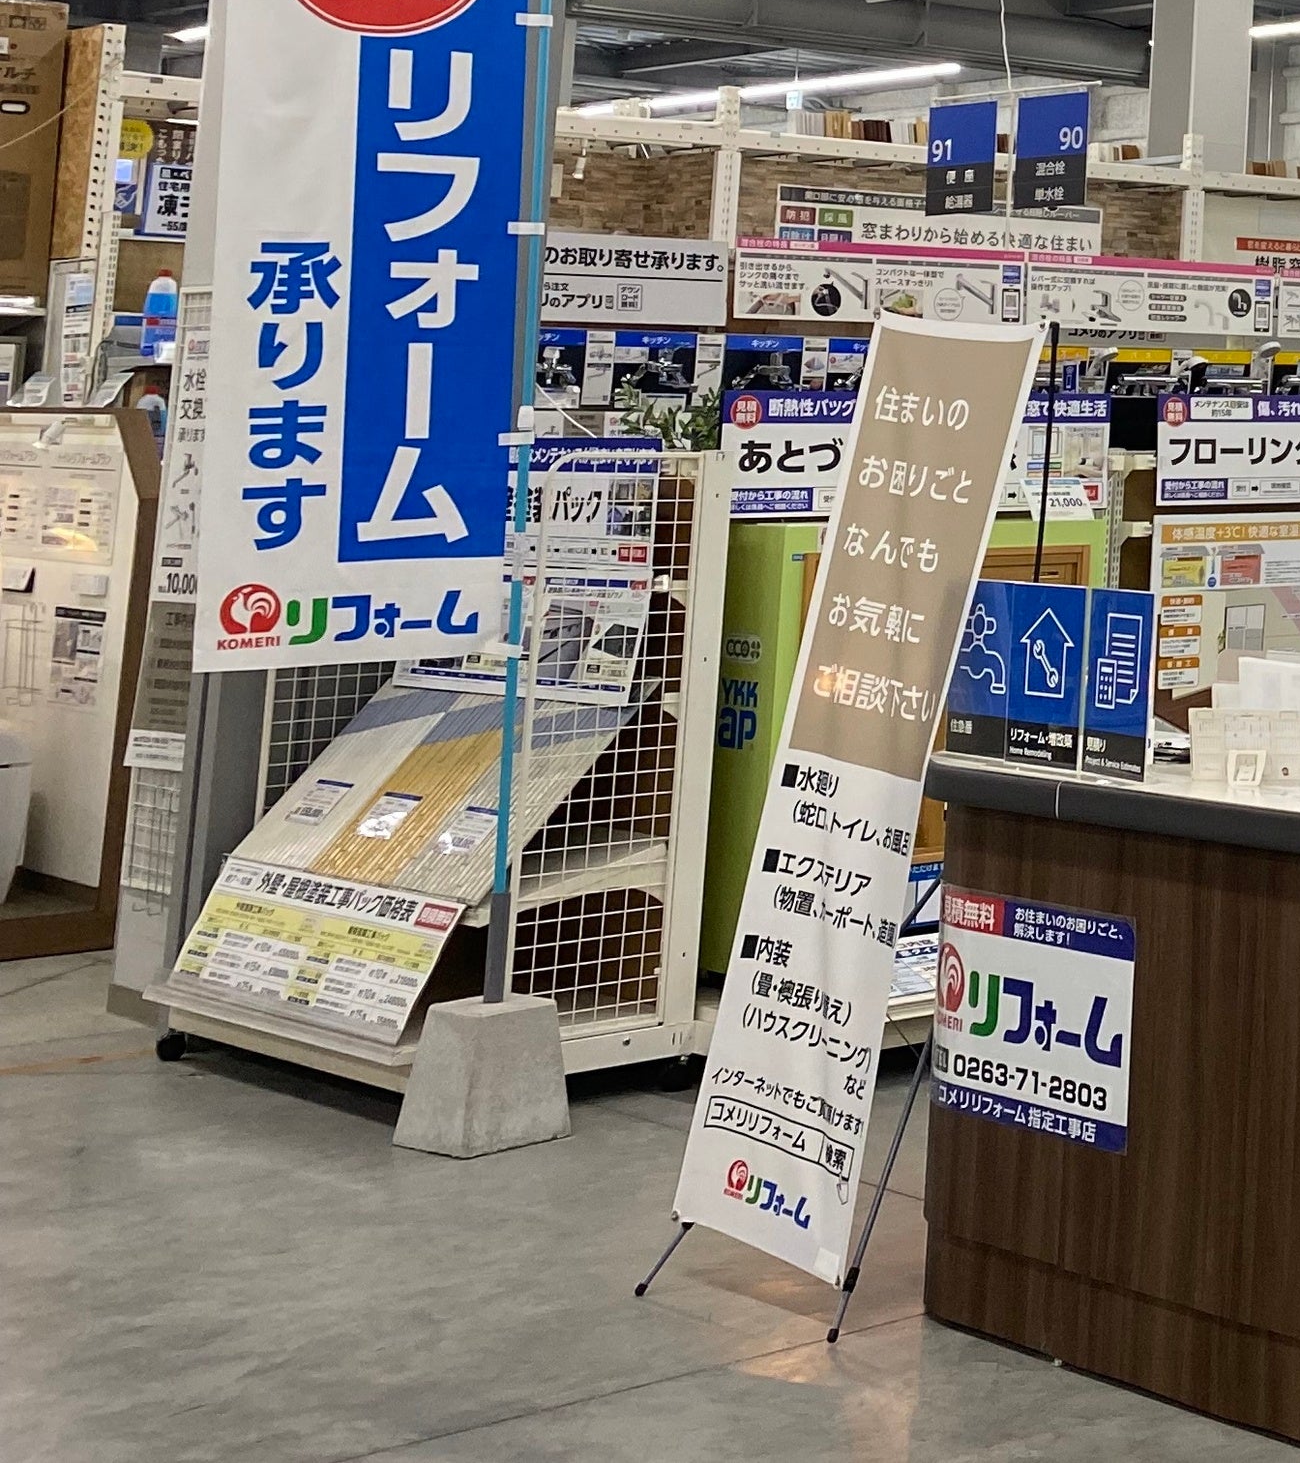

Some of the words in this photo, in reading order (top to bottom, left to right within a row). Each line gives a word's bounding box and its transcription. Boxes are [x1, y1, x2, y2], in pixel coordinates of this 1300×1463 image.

[932, 139, 953, 163] 91
[1059, 127, 1084, 151] 90
[356, 48, 480, 543] リフォーム
[242, 242, 342, 551] 承ります
[875, 384, 971, 432] 住まいの
[858, 455, 974, 505] お困りごと
[843, 522, 940, 573] なんでも
[217, 636, 281, 650] KOMERI
[286, 590, 478, 647] リフォーム
[827, 592, 926, 645] お気軽に
[722, 678, 759, 708] YKK
[813, 663, 937, 722] ご相談下さい
[718, 708, 757, 750] ap
[1008, 746, 1023, 755] Home
[1023, 748, 1053, 761] Remodeling
[1013, 922, 1071, 947] 解決します!
[1014, 907, 1124, 940] お住まいのお困りごと、
[757, 936, 793, 968] 内装
[968, 970, 1123, 1069] リフォーム
[843, 1074, 867, 1100] など
[952, 1053, 1108, 1112] 0263-71-2803
[710, 1102, 807, 1152] コメリリフォーム
[938, 1084, 1097, 1143] コメリリフォーム指定工事店
[745, 1175, 812, 1229] リフォーム
